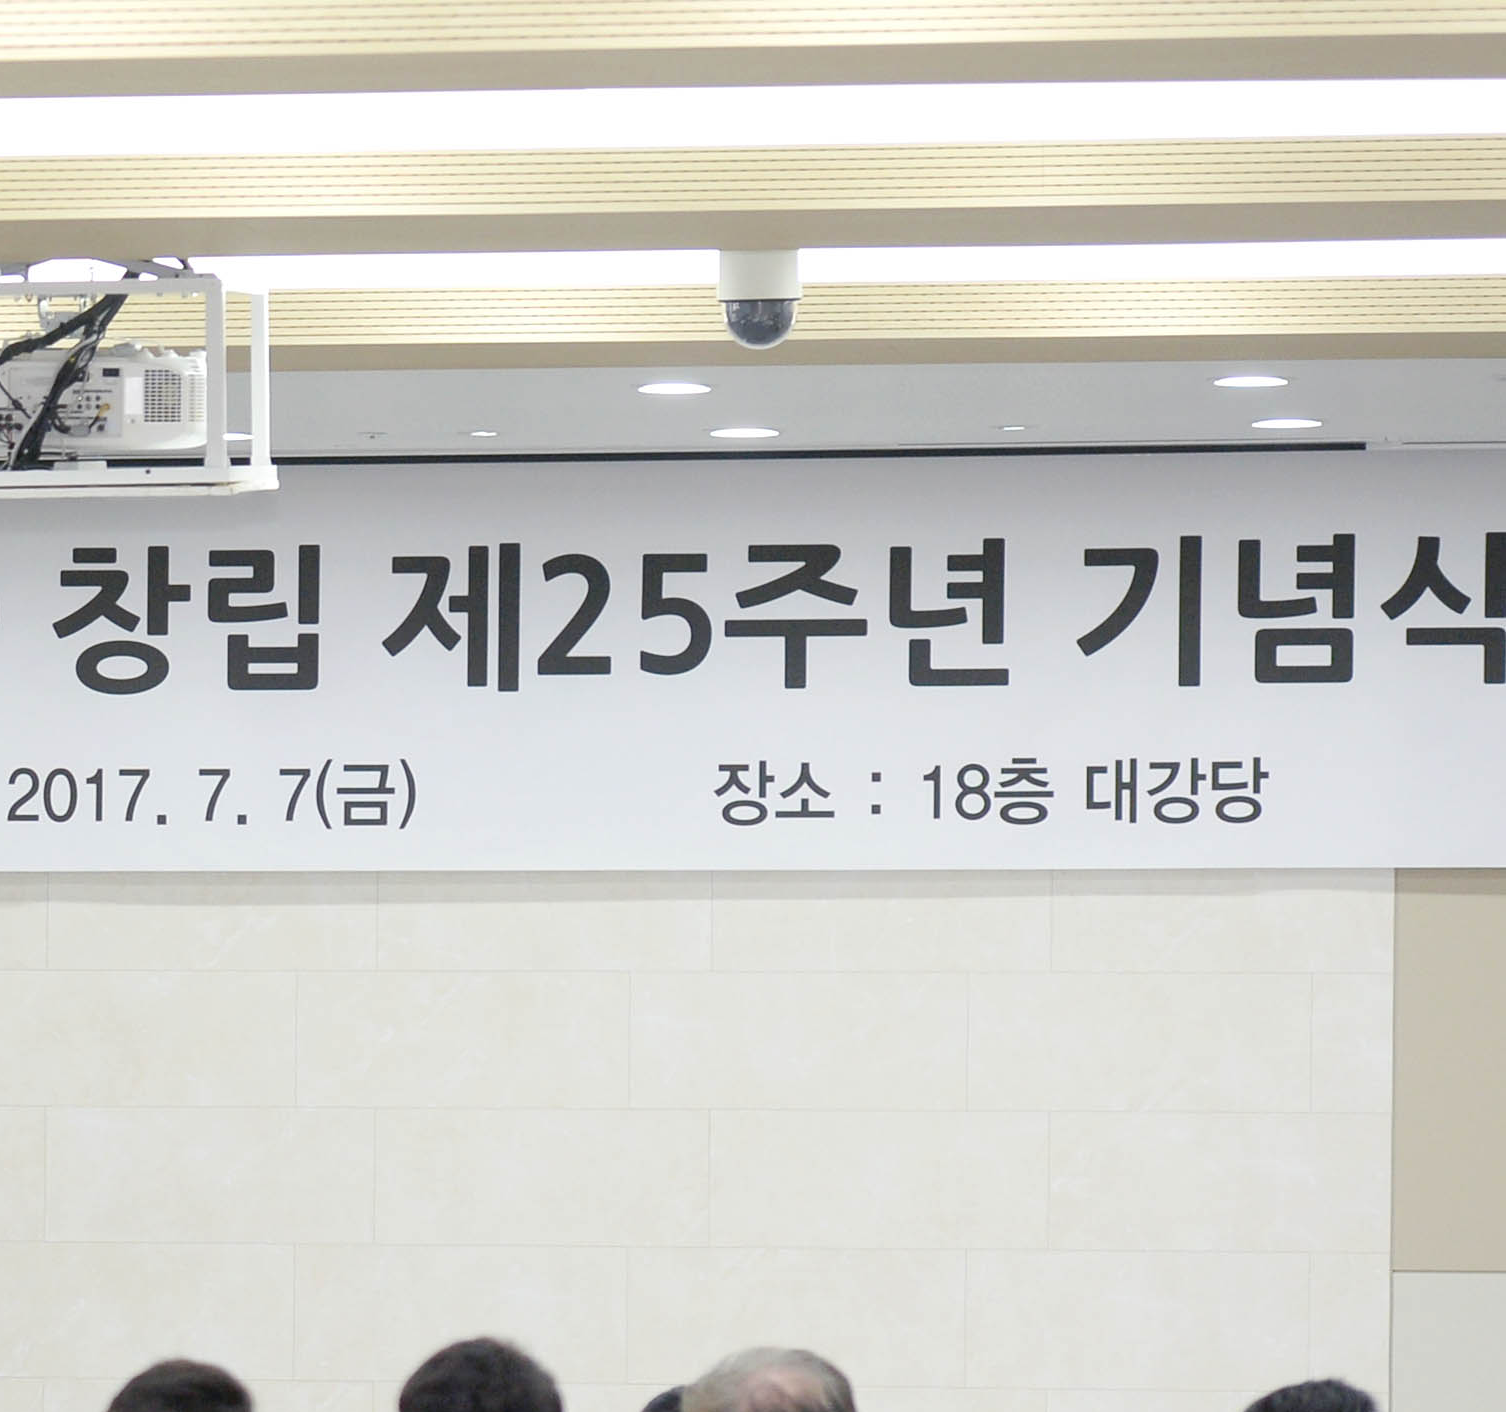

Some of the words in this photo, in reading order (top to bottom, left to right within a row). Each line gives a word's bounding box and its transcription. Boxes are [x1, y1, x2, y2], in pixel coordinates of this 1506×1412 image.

[52, 544, 320, 695] 창립
[382, 538, 1009, 692] 제25주년
[1076, 532, 1506, 687] 기념식
[7, 768, 166, 826] 2017.
[199, 769, 247, 826] 7.
[279, 759, 416, 829] 7(금)
[714, 760, 835, 826] 장소
[923, 758, 1054, 825] 18층
[1086, 757, 1269, 824] 대강당
